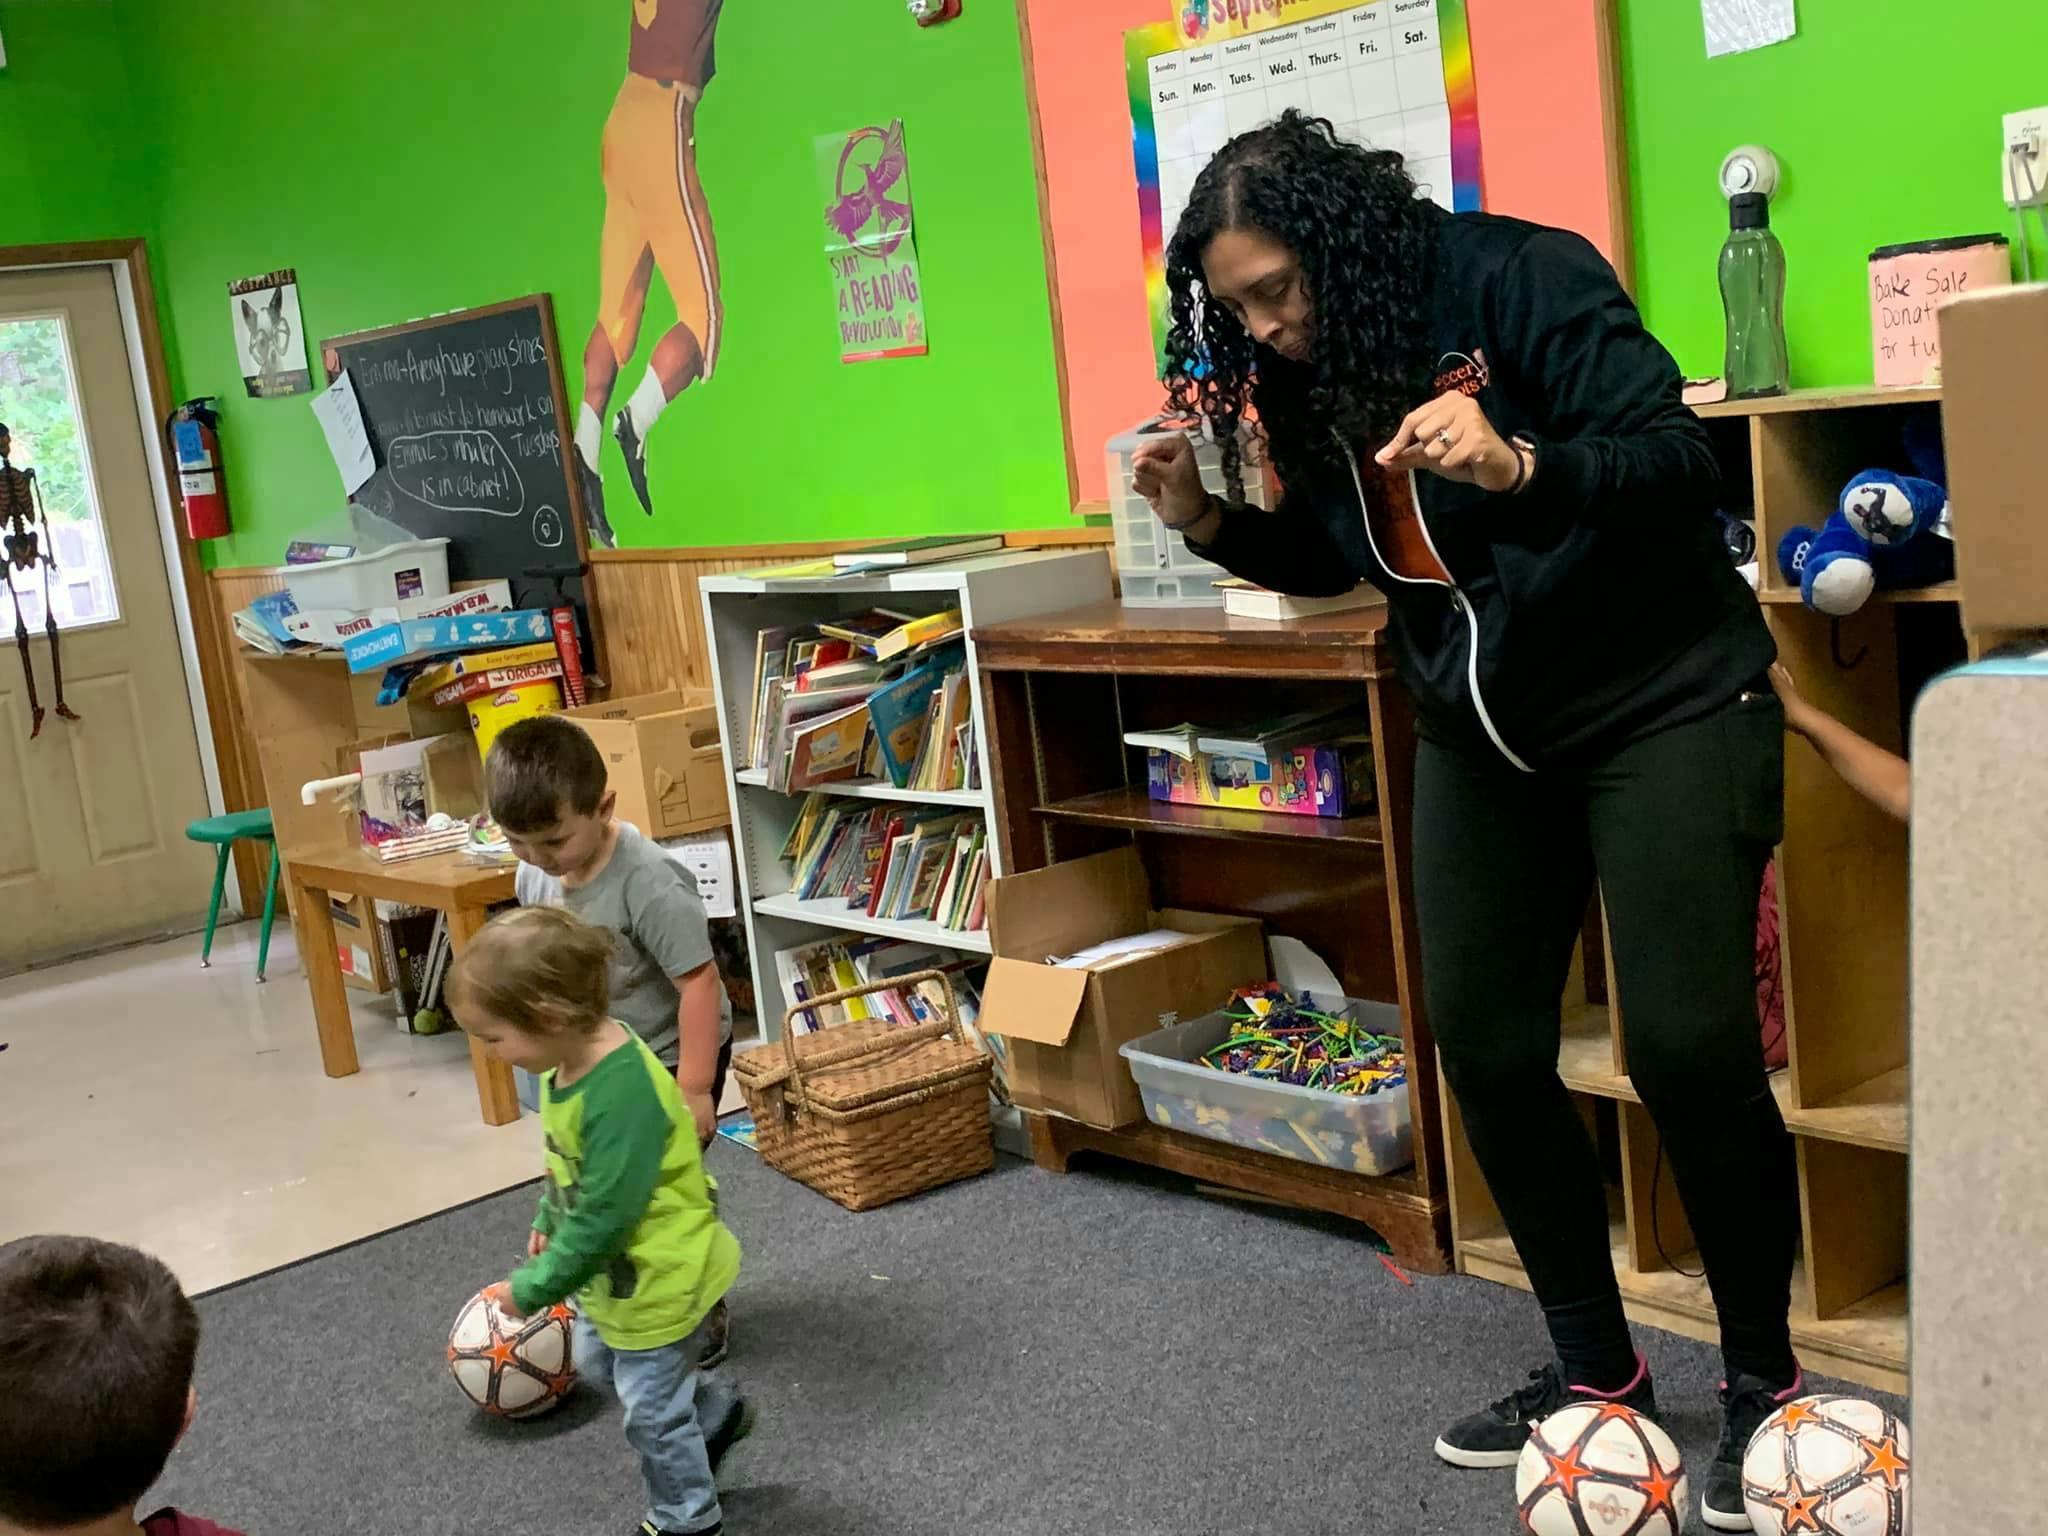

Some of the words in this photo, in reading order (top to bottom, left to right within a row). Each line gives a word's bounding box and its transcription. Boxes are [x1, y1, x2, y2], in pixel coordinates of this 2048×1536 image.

[1155, 61, 1177, 73] Sunday
[1190, 52, 1213, 64] Monday
[1225, 43, 1251, 55] Tuesday
[1259, 31, 1298, 46] Wednesday
[1304, 21, 1337, 34] Thursday
[1352, 11, 1377, 23] Friday
[1395, 0, 1430, 13] Saturday
[1158, 90, 1179, 103] Sun.
[1192, 81, 1217, 95] Mon.
[1229, 73, 1256, 86] Tues.
[1268, 59, 1297, 76] Wed.
[1308, 52, 1342, 66] Thurs.
[1359, 40, 1378, 55] Fri.
[1404, 30, 1428, 44] Sat.
[839, 288, 849, 312] A
[850, 264, 919, 318] READING
[1874, 272, 1911, 303] Bake
[1926, 268, 1968, 295] Sale
[1882, 299, 1938, 329] Donat
[1880, 337, 1898, 360] for
[1433, 363, 1473, 387] occer
[505, 661, 558, 682] ORIGAMI
